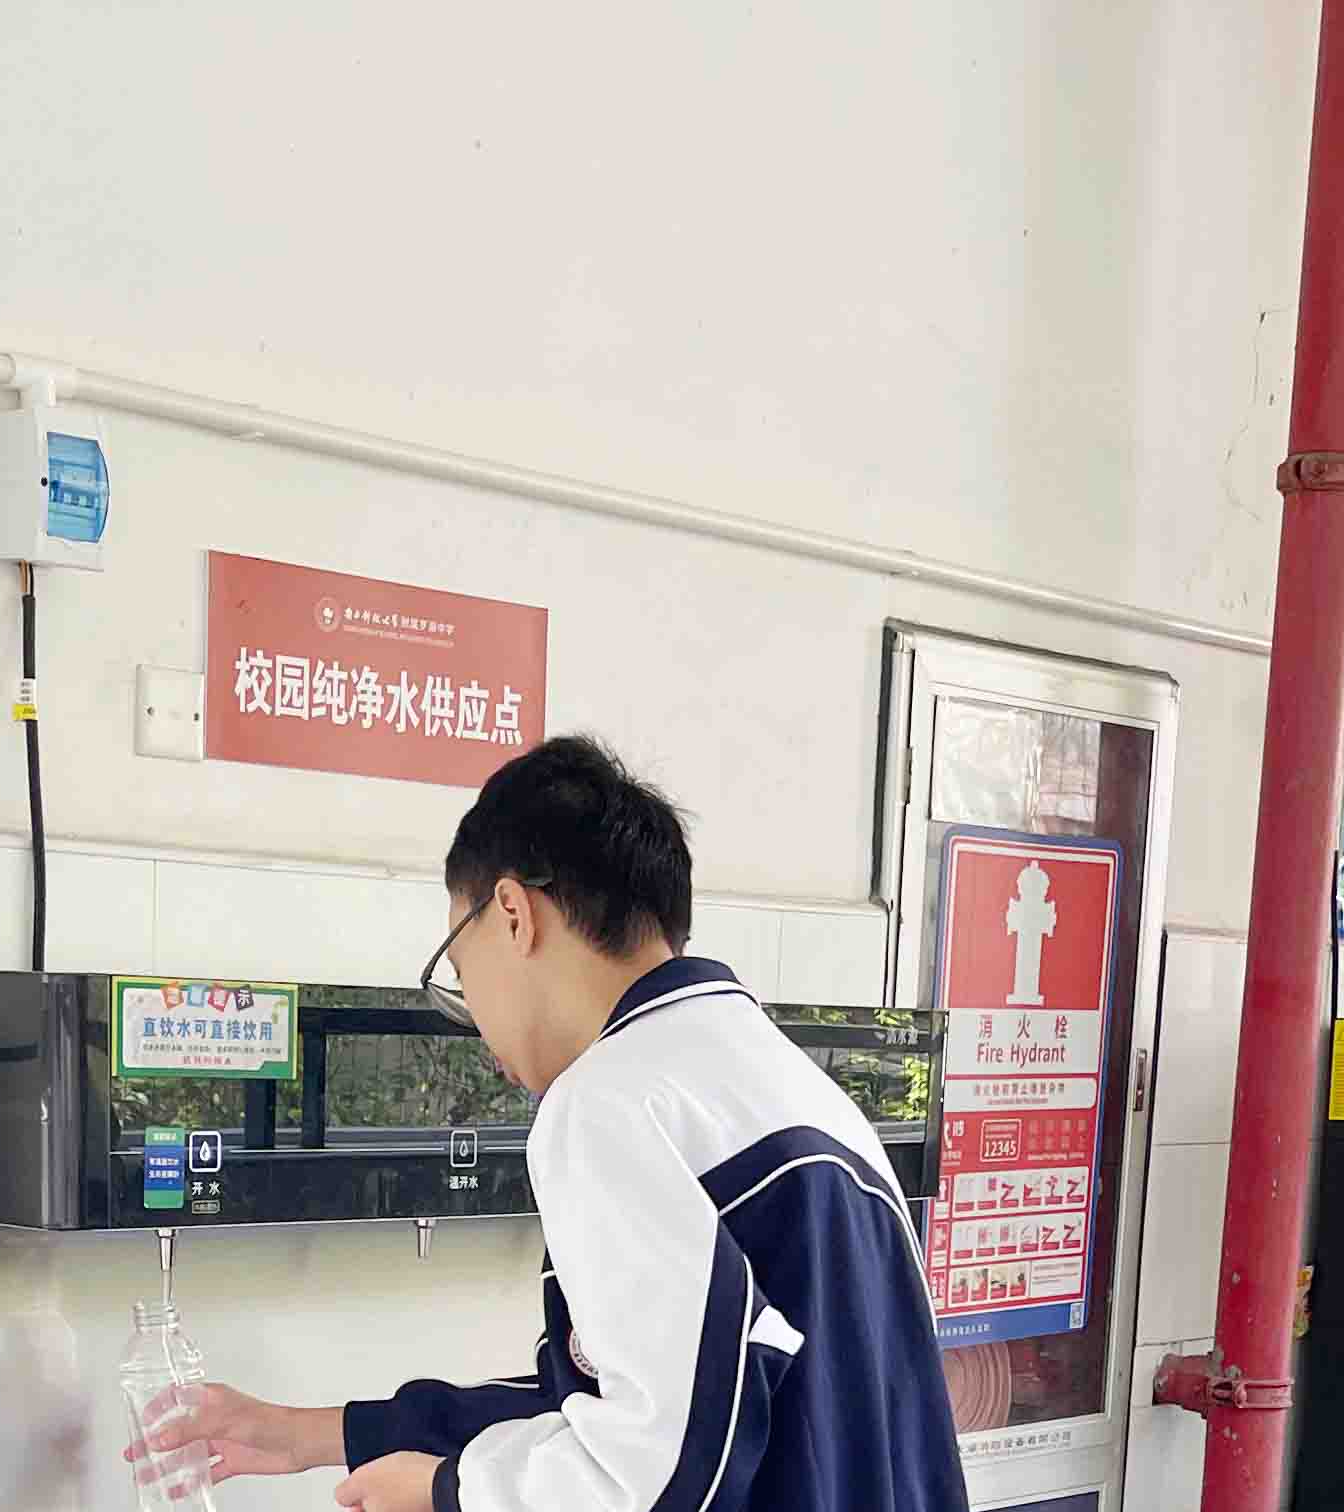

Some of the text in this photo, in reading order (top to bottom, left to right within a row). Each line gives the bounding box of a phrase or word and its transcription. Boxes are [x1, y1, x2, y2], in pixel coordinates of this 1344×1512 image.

[234, 647, 523, 745] 校园纯净水供应点
[143, 1018, 272, 1041] 直饮水可直接饮用
[978, 1013, 1067, 1039] 消火栓
[977, 1041, 1066, 1068] Fire Hydrant
[984, 1140, 1017, 1157] 12345
[192, 1181, 220, 1196] 开水
